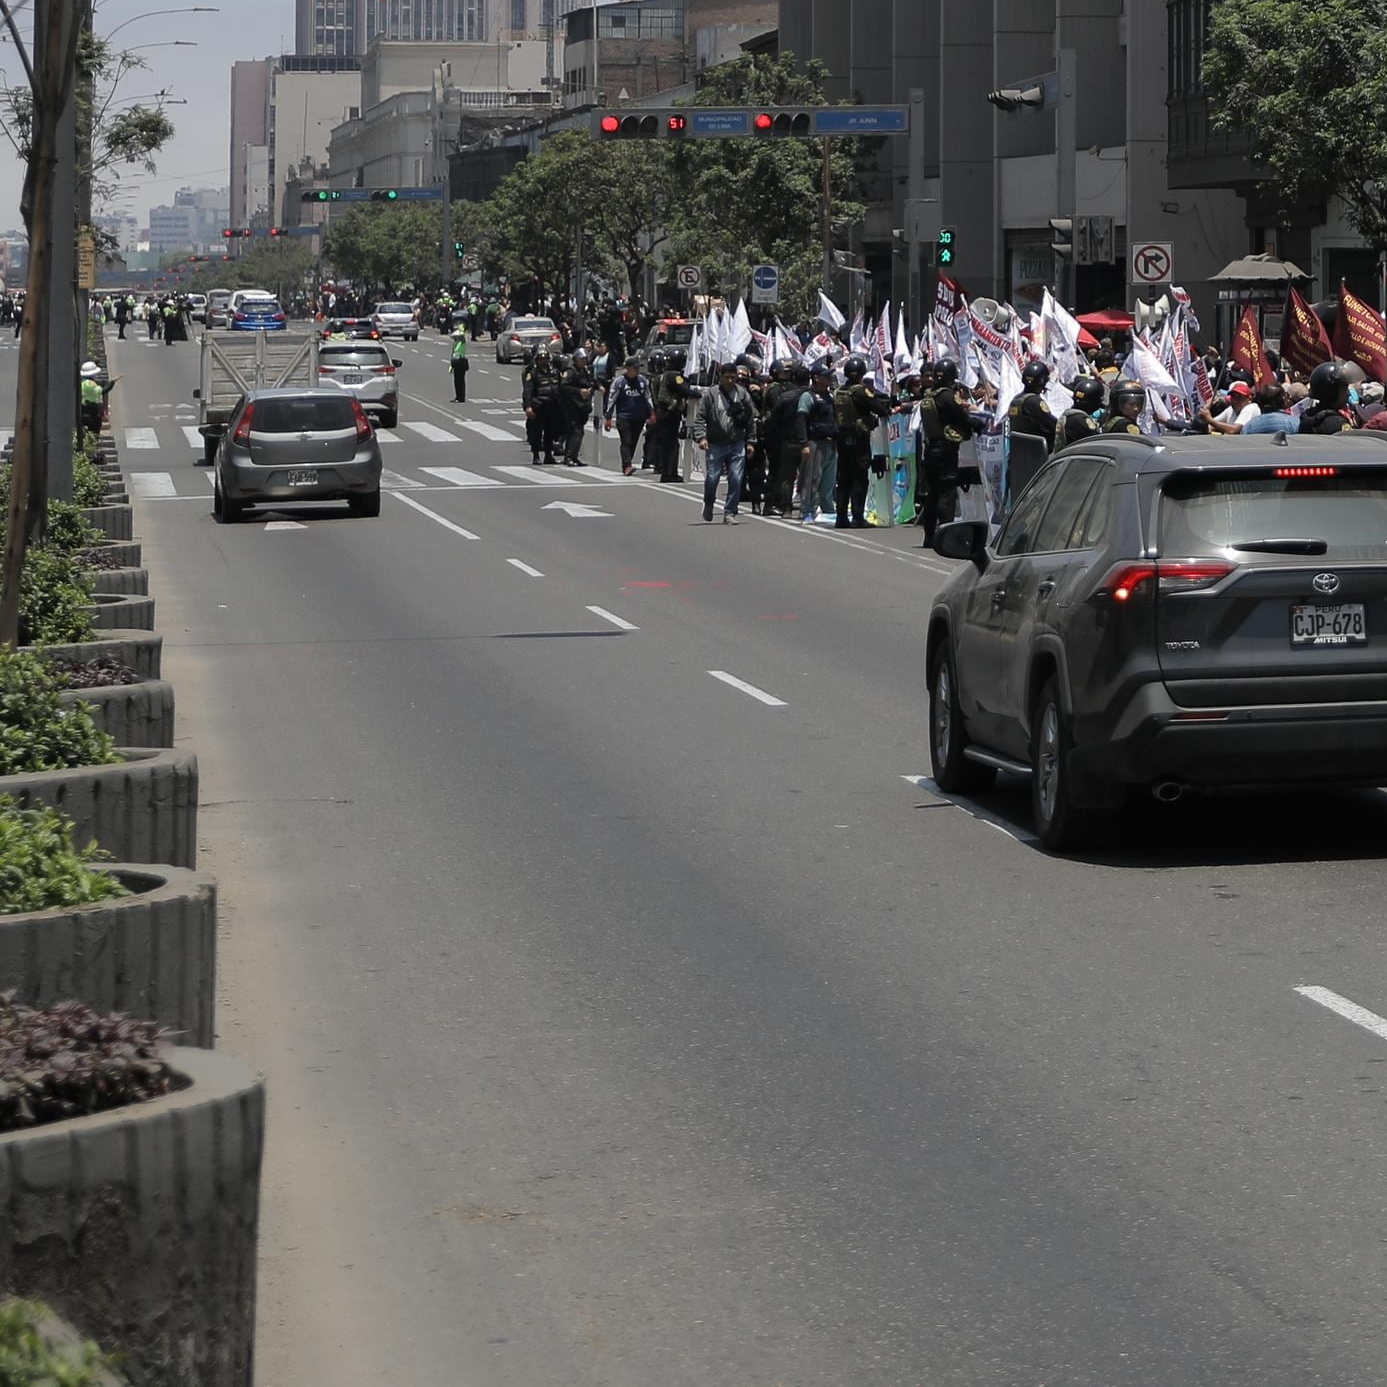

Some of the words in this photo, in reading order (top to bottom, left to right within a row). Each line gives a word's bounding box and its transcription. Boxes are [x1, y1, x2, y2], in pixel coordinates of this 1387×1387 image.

[669, 117, 684, 130] 51
[1294, 613, 1363, 638] CJP-678
[1165, 640, 1201, 650] TOYOTA
[1313, 636, 1348, 645] MITSUI
